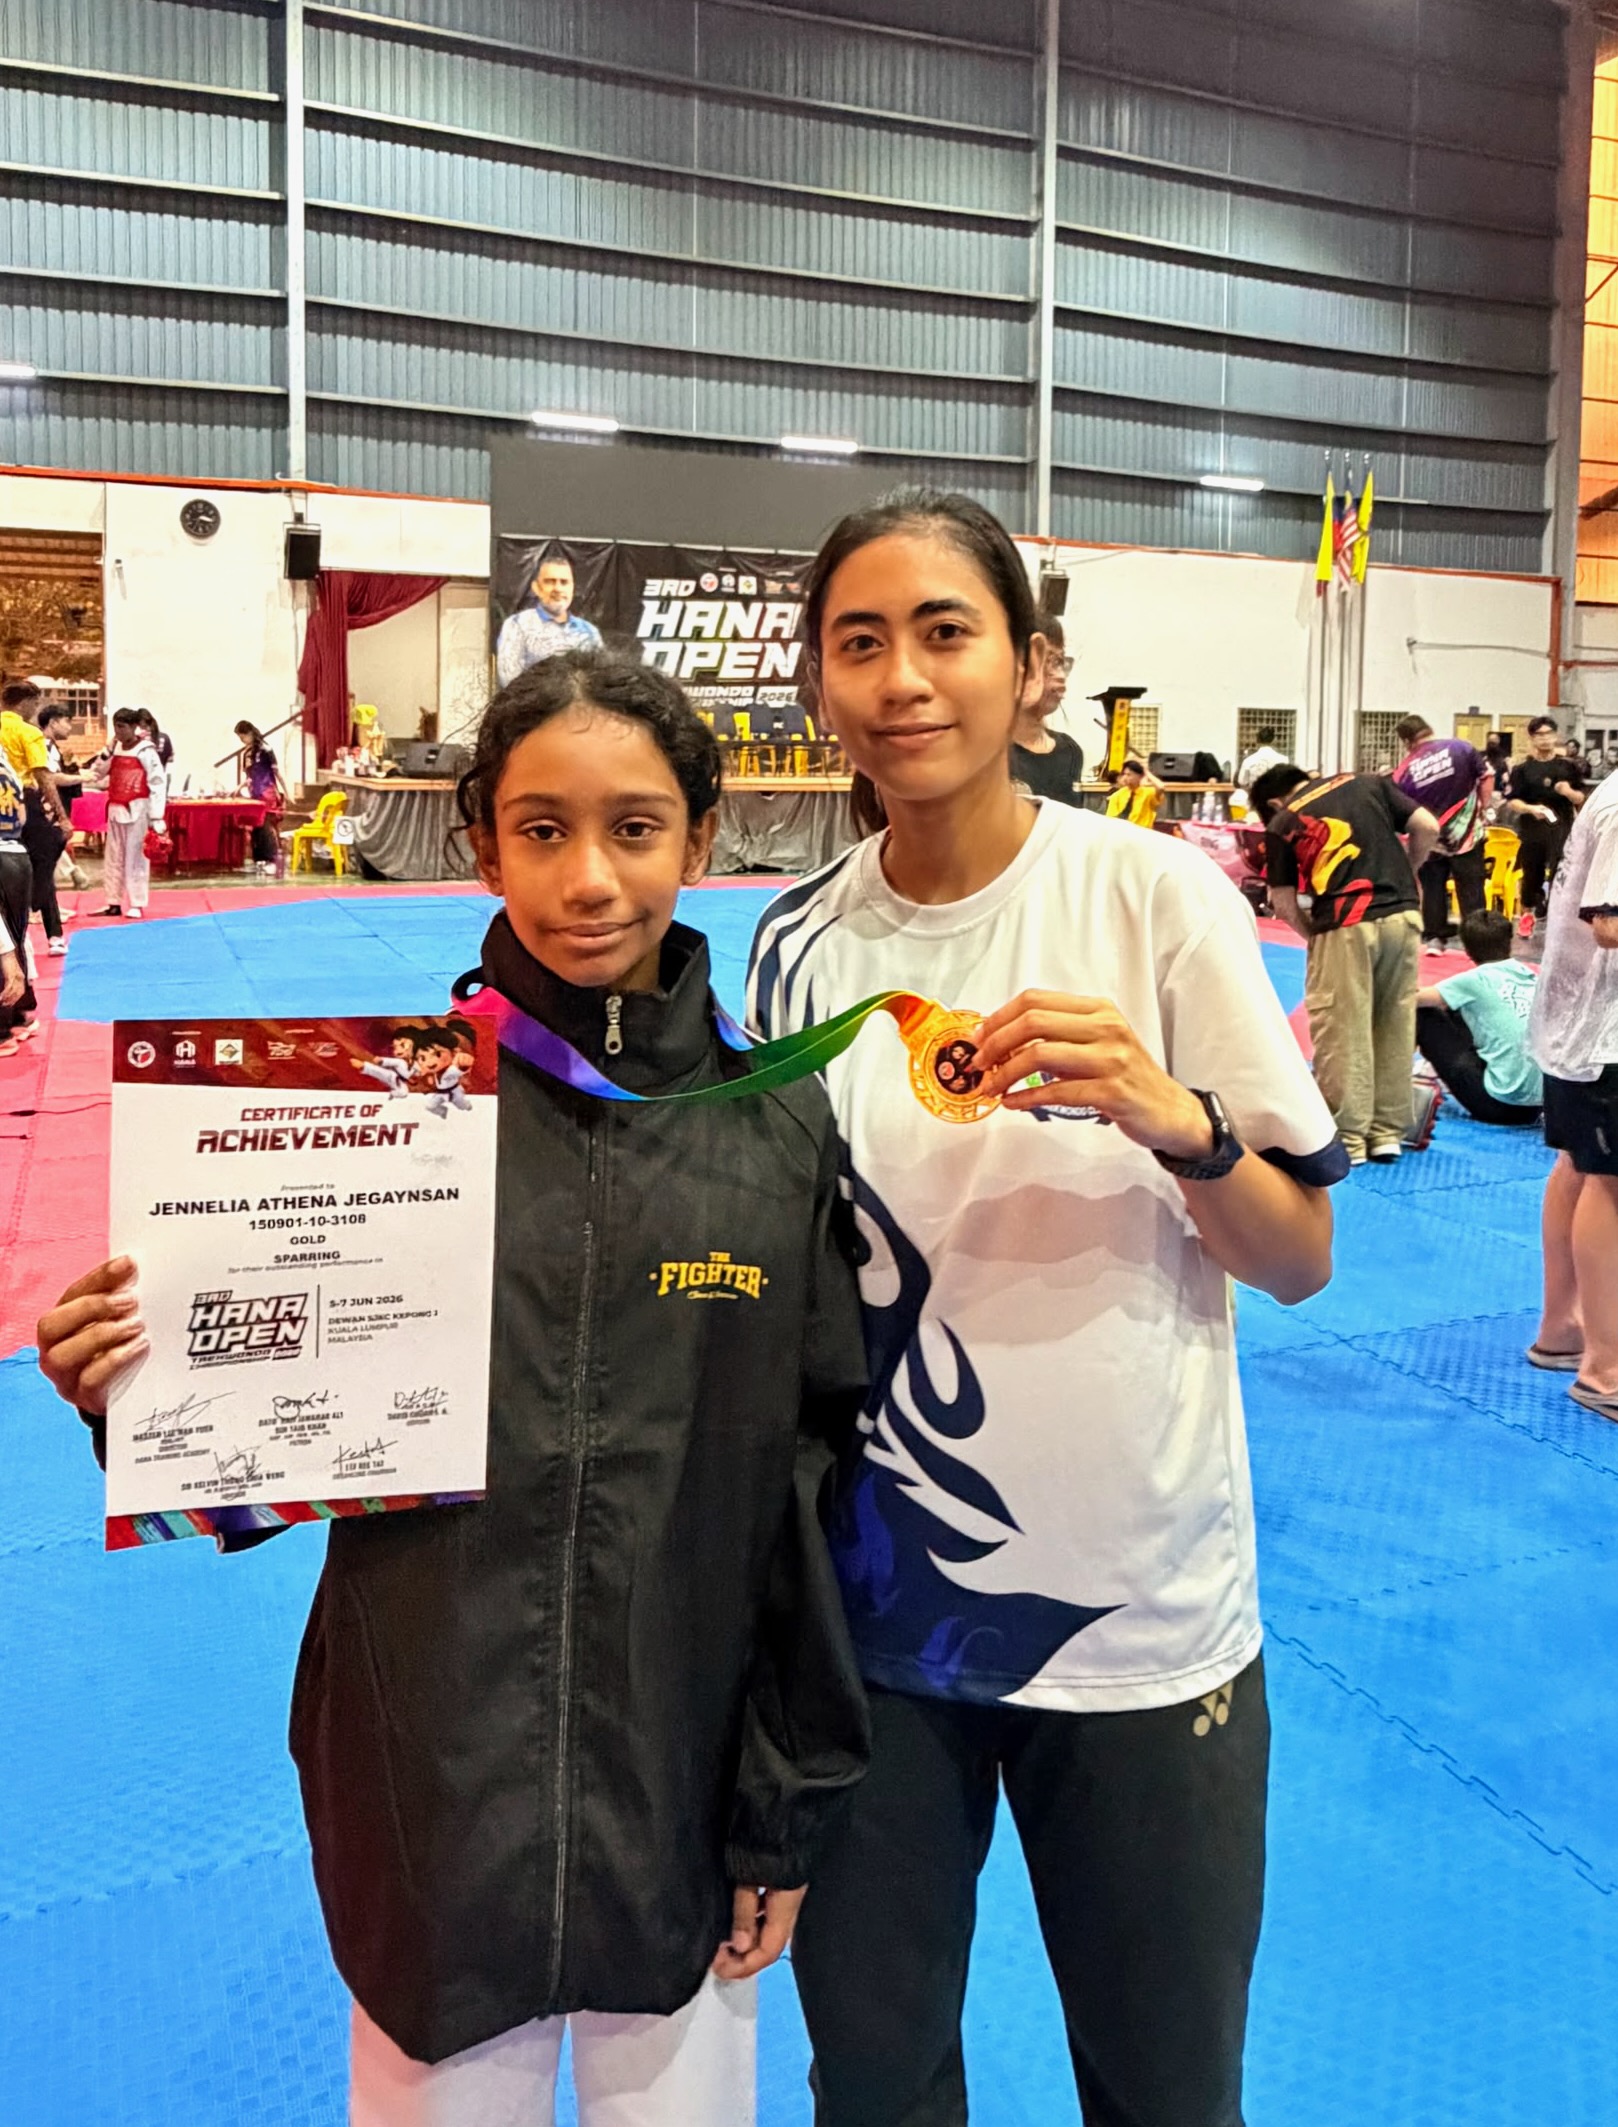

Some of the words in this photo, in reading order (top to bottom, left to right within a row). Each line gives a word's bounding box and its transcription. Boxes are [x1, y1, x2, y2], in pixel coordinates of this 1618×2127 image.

[643, 579, 696, 597] 3RD
[636, 600, 802, 638] HANA
[641, 641, 802, 679] OPEN
[240, 1105, 356, 1122] CERTIFICATE
[360, 1104, 383, 1118] OF
[196, 1122, 420, 1153] ACHIEVEMENT
[149, 1199, 251, 1216] JENNELIA
[256, 1194, 338, 1211] ATHENA
[343, 1187, 460, 1206] JEGAYNSAN
[249, 1213, 366, 1230] 150901-10-3108
[290, 1234, 326, 1245] GOLD
[273, 1250, 341, 1264] SPARRING
[657, 1262, 761, 1299] FIGHTER
[329, 1298, 347, 1308] 5-7
[350, 1297, 373, 1307] JUN
[376, 1294, 404, 1305] 2026
[189, 1294, 307, 1330] HANA
[328, 1315, 365, 1325] DEWAN
[189, 1318, 307, 1355] OPEN
[327, 1334, 373, 1344] MALAYSIA
[328, 1326, 358, 1334] KUALA
